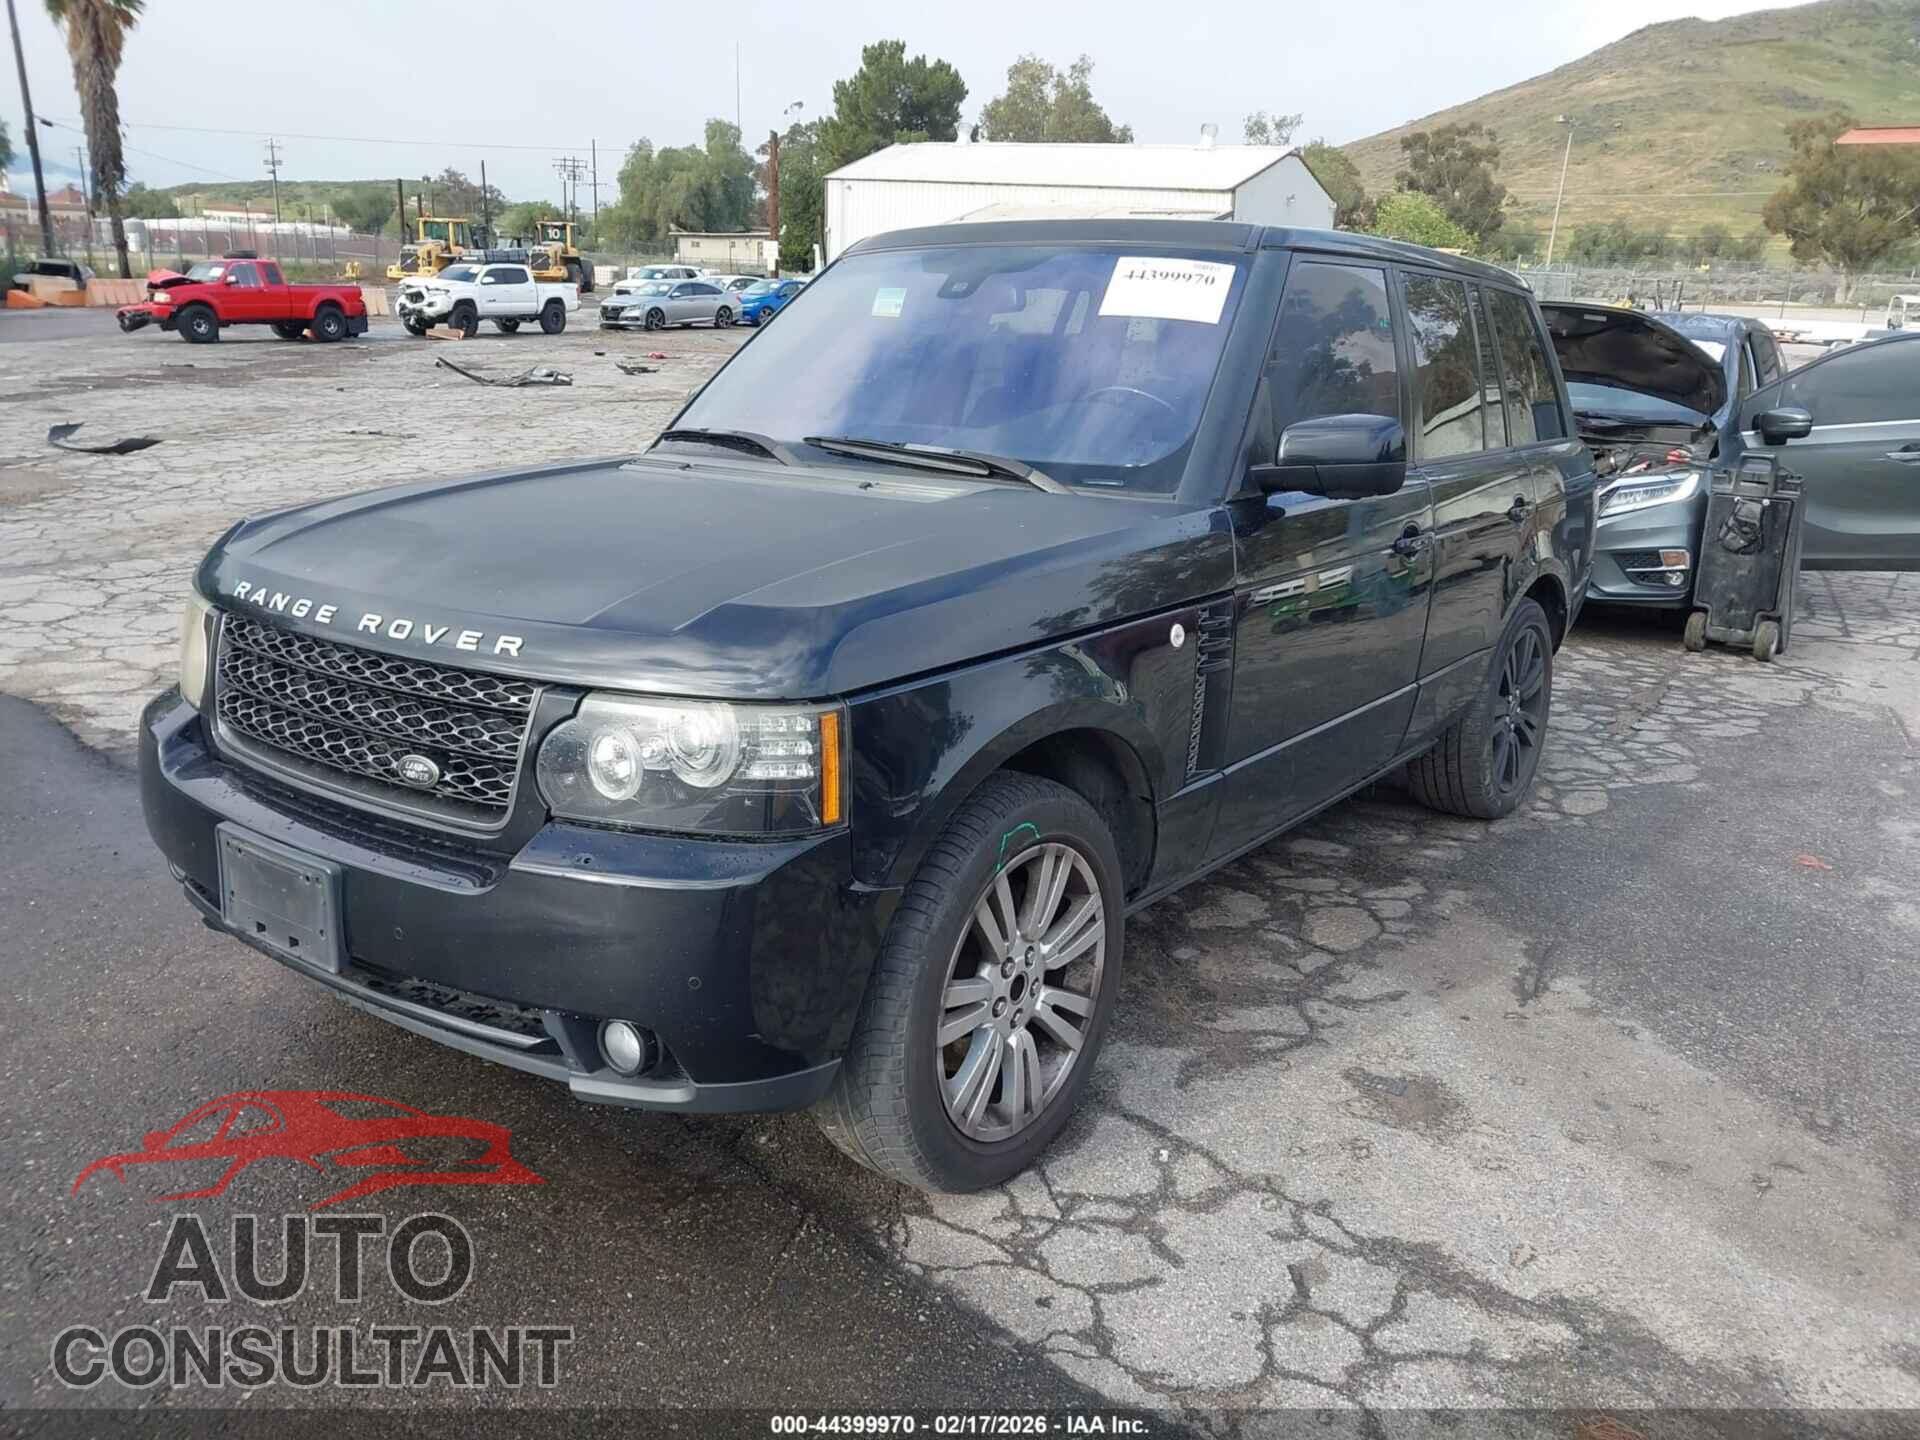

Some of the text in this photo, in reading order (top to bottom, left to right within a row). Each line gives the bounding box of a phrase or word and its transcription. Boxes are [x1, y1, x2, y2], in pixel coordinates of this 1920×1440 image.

[547, 228, 560, 239] 10
[1123, 269, 1216, 285] 44399970
[233, 580, 526, 657] RANGE ROVER
[406, 770, 429, 781] ROVER
